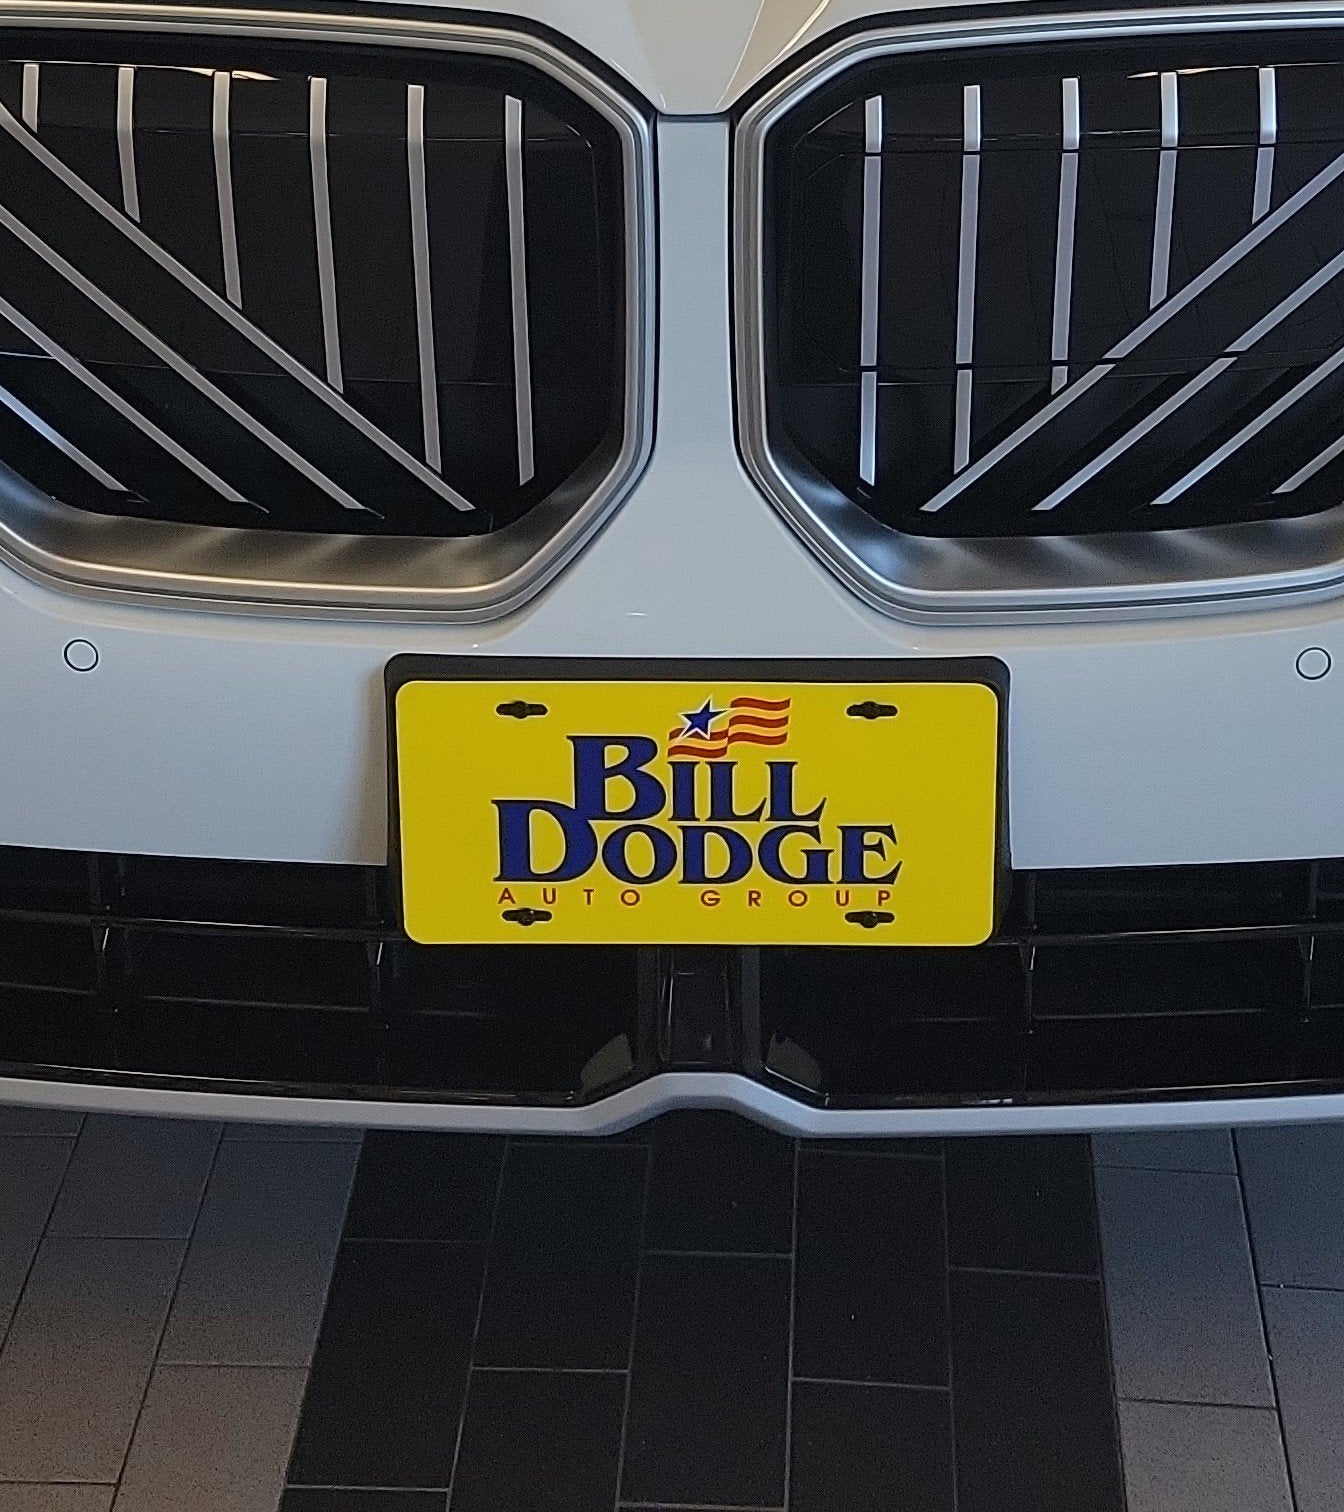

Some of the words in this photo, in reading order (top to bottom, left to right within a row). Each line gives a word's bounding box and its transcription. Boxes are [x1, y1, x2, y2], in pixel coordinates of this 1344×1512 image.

[565, 735, 828, 823] BILL
[490, 798, 904, 886] DODGE
[498, 888, 641, 907] AUTO
[700, 889, 896, 908] GROUP
